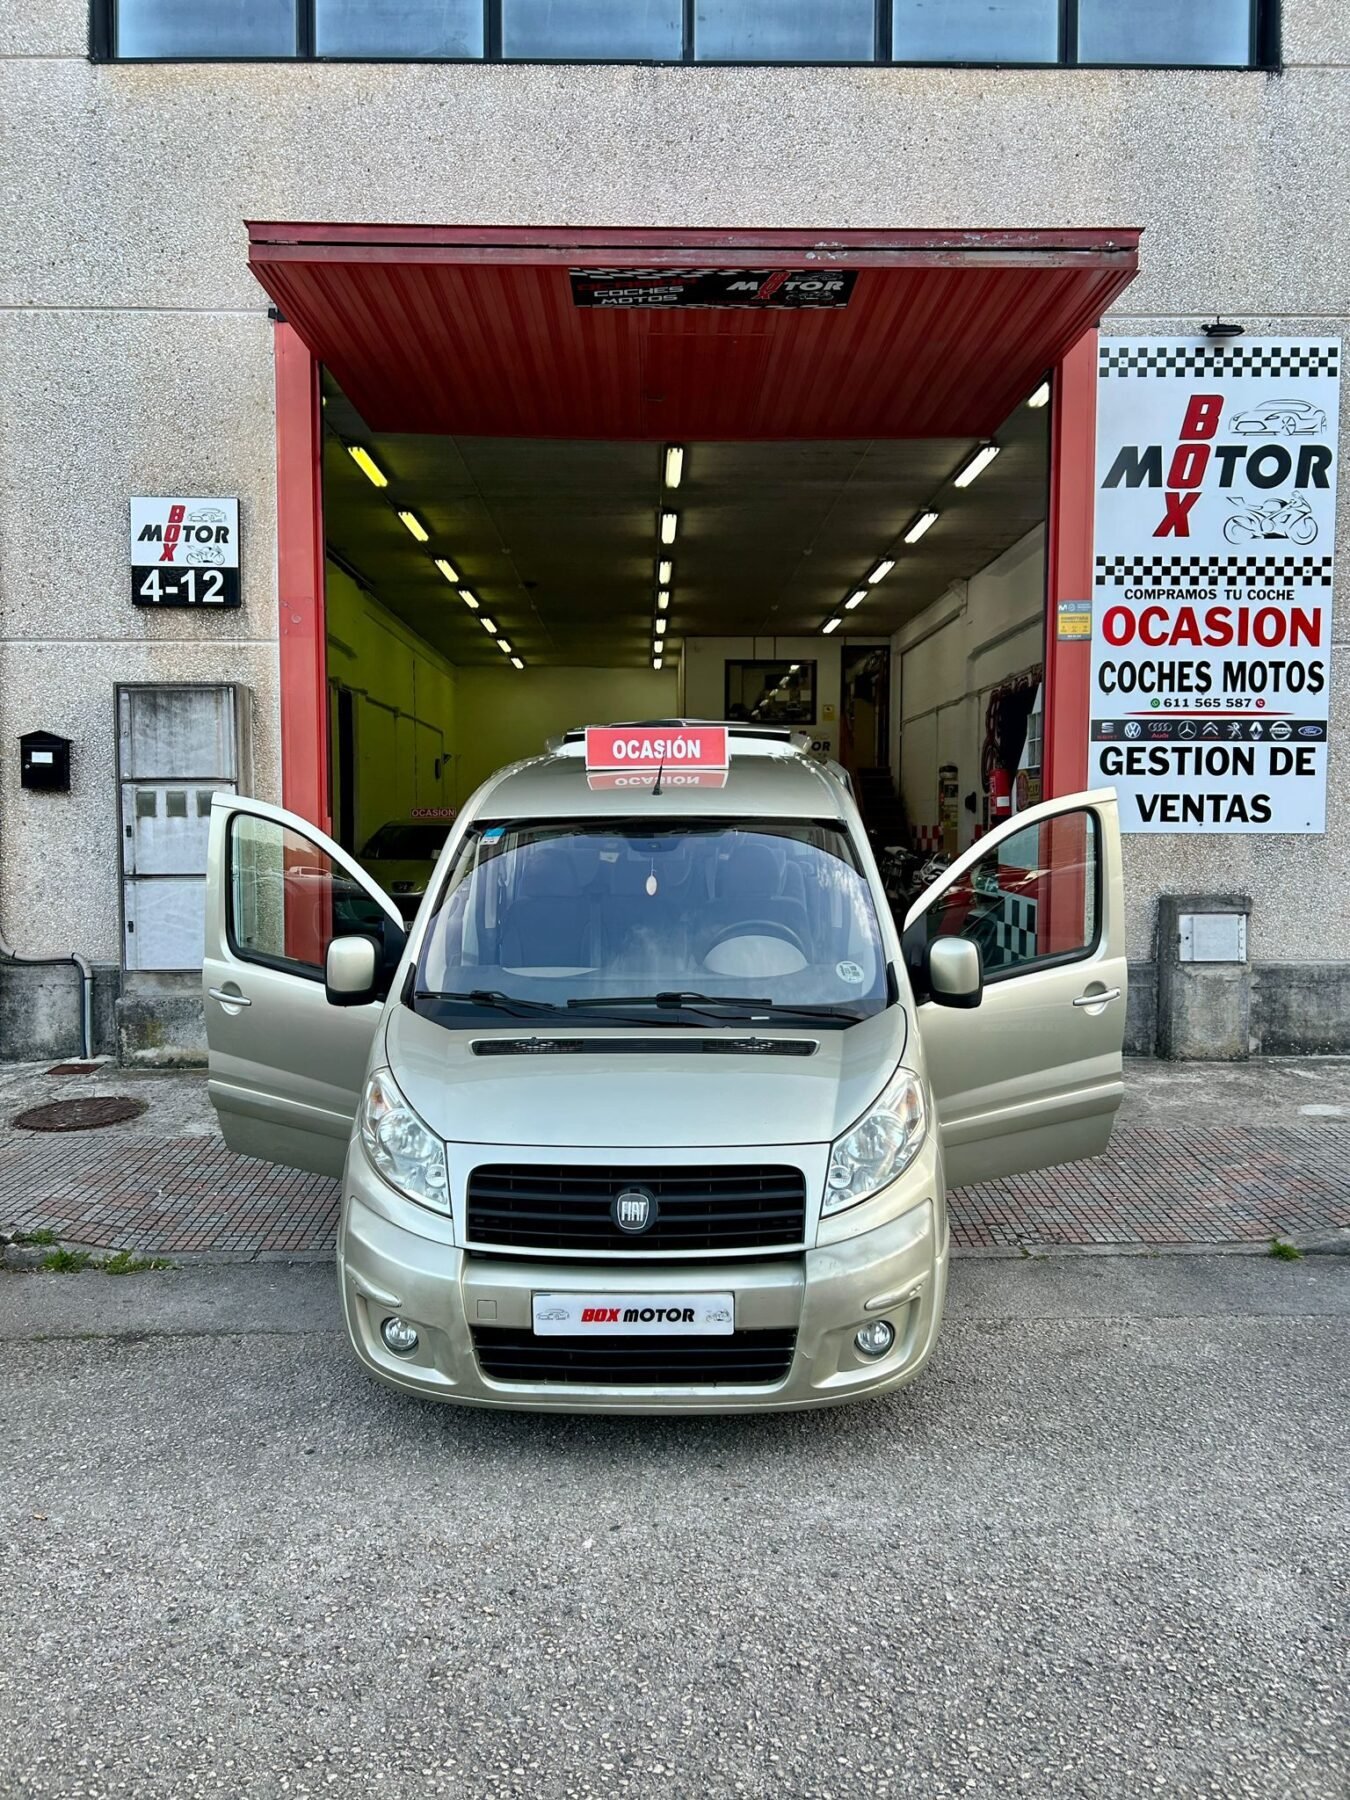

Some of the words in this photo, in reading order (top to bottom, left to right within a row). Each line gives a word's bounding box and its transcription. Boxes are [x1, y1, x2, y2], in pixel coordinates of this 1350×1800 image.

[594, 285, 684, 298] COCHES
[601, 294, 678, 305] MOTOS
[1101, 443, 1332, 489] MOTOR
[1152, 395, 1224, 537] BOX
[137, 524, 230, 543] MOTOR
[159, 505, 185, 561] BOX
[140, 569, 224, 602] 4-12
[1124, 588, 1217, 600] COMPRAMOS
[1224, 589, 1242, 600] TU
[1247, 589, 1295, 600] COCHE
[1102, 605, 1322, 647] OCASION
[1098, 660, 1212, 694] COCHES
[1222, 660, 1325, 694] MOTOS
[1163, 698, 1189, 708] 611
[1194, 698, 1221, 708] 565
[1225, 698, 1252, 708] 587
[612, 736, 701, 759] OCASIÓN
[1099, 746, 1254, 776] GESTION
[1269, 747, 1316, 776] DE
[411, 808, 454, 817] OCASION
[1136, 794, 1272, 823] VENTAS
[621, 1201, 647, 1221] FIAT
[581, 1308, 621, 1322] BOX
[623, 1308, 695, 1322] MOTOR
